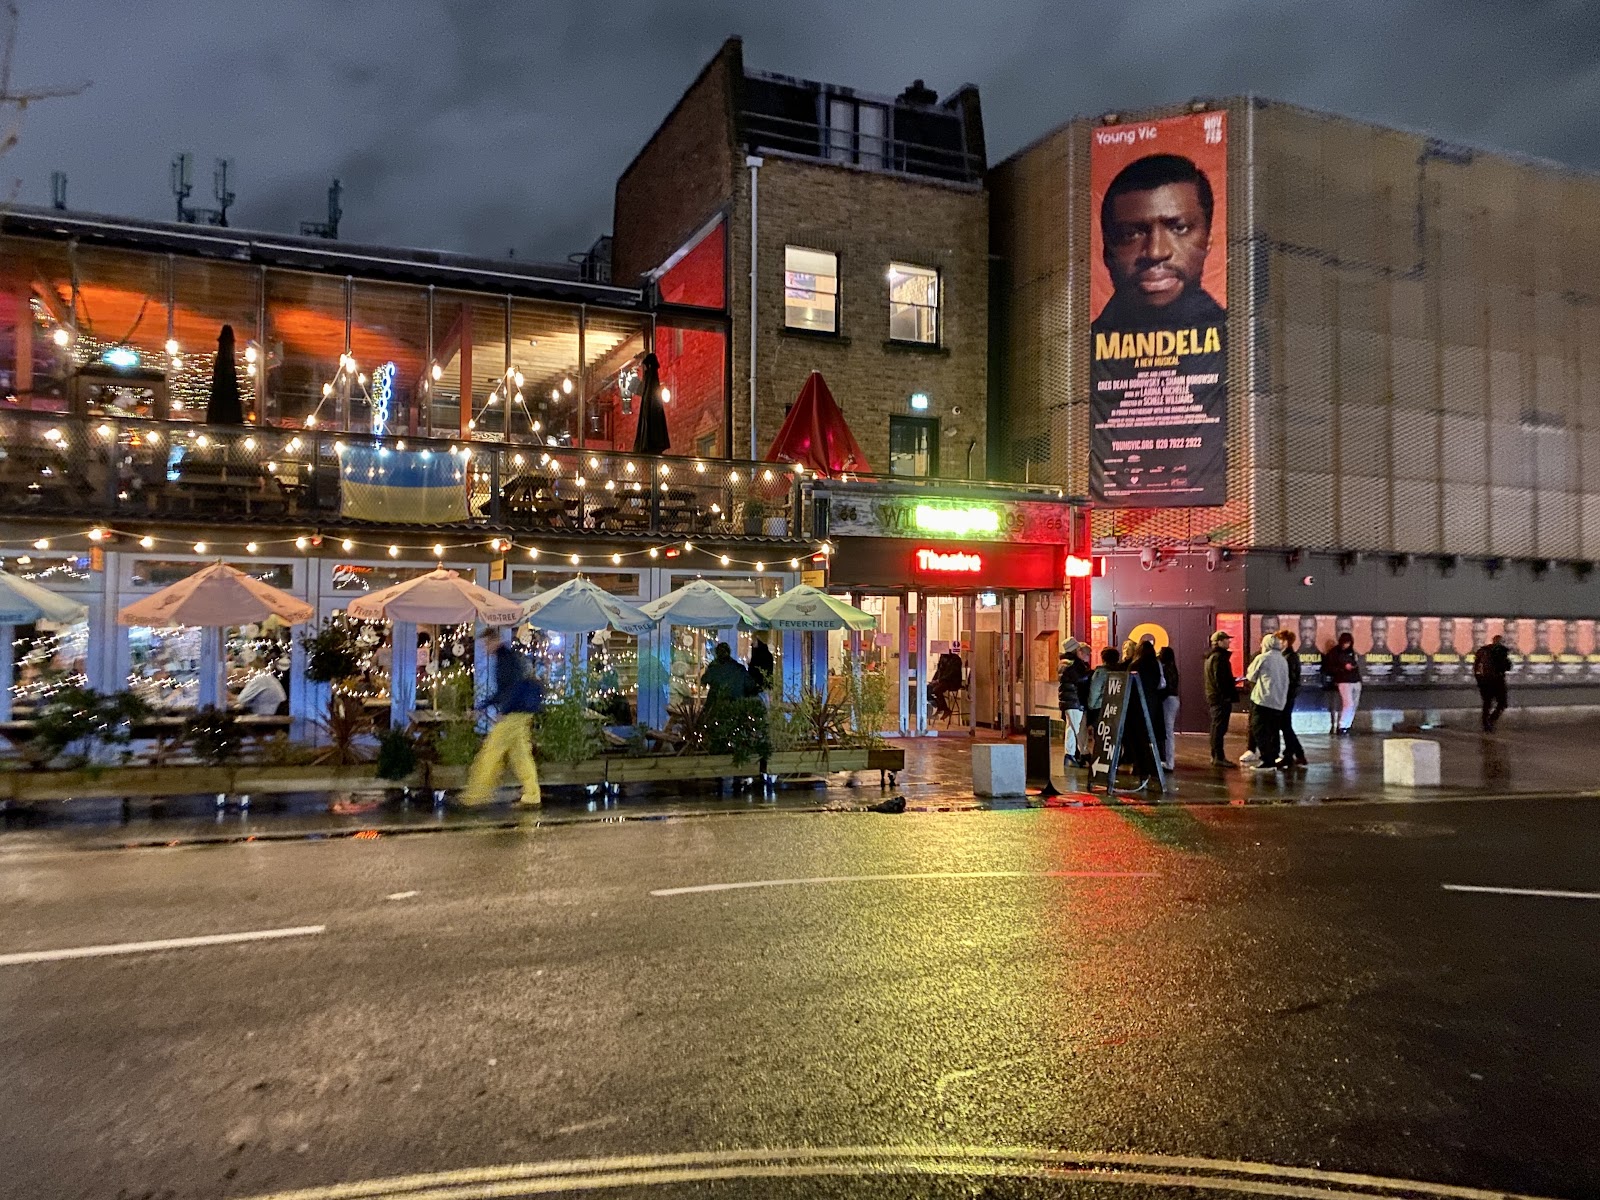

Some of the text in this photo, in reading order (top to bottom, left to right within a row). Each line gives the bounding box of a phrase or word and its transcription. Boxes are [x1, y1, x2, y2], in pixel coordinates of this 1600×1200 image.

[1096, 126, 1157, 145] Young Vic
[1095, 326, 1221, 361] MANDELA
[1134, 355, 1180, 368] A NEW MUSICAL
[1112, 439, 1154, 451] YOUNGVIC.ORG
[1156, 438, 1168, 449] 020
[841, 504, 858, 521] 66
[1047, 518, 1062, 530] 66
[916, 549, 981, 572] Theatre
[1097, 720, 1116, 761] OPEN
